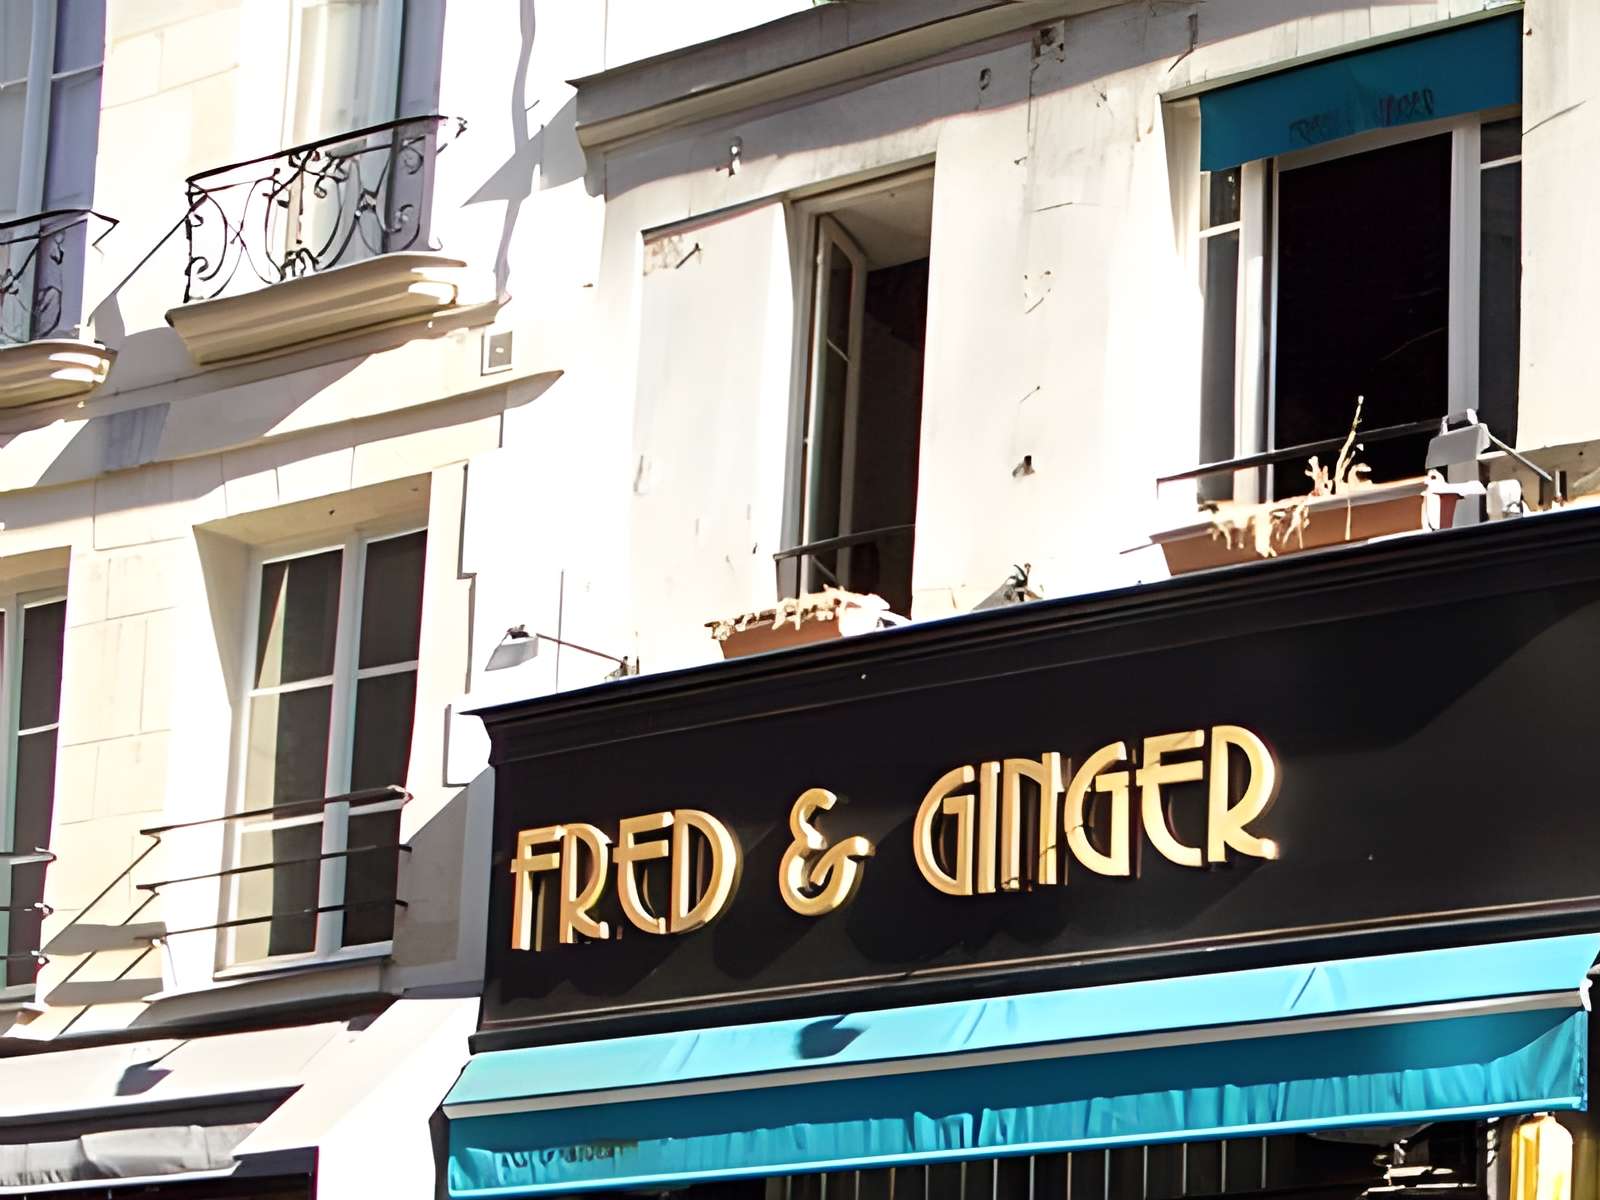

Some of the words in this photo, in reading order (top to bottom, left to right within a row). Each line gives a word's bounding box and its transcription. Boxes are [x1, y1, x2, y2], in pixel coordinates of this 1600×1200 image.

[510, 808, 740, 950] FRED
[778, 787, 873, 916] &
[912, 724, 1280, 896] GINGER
